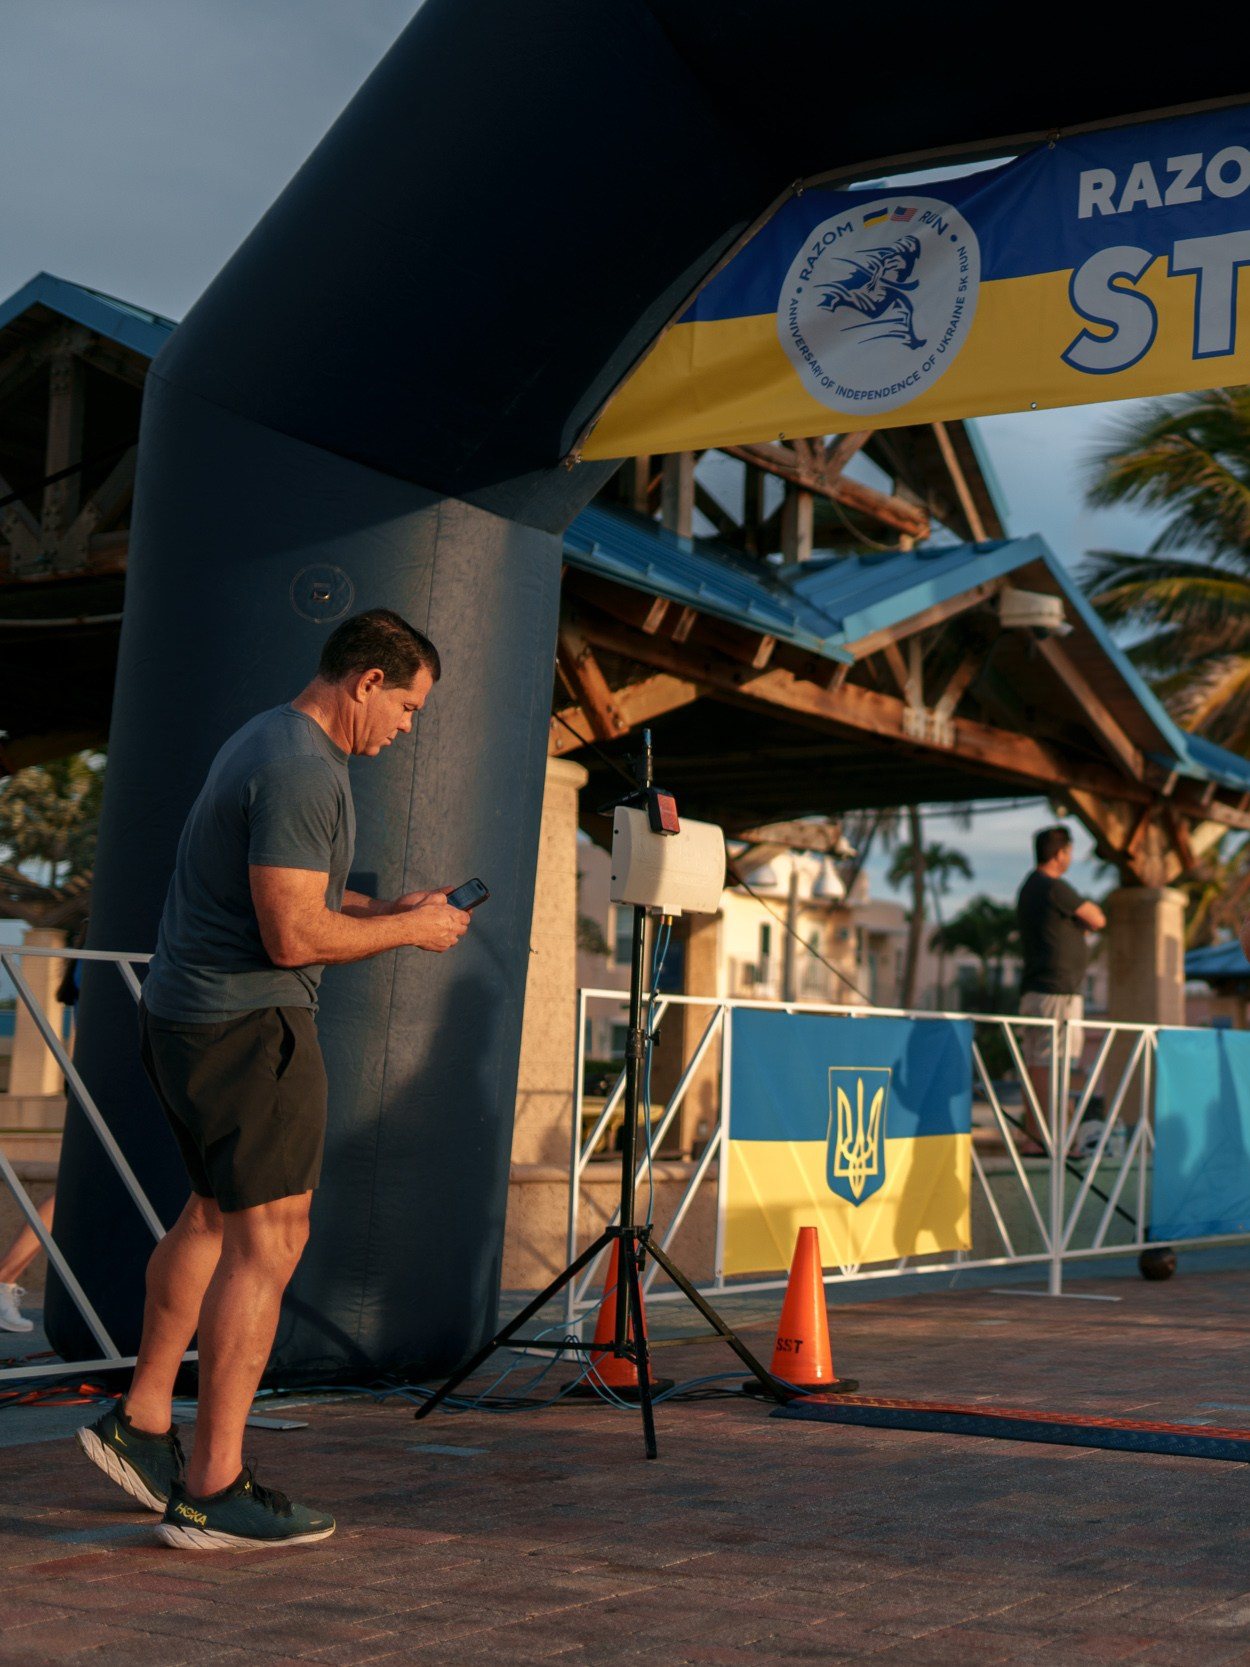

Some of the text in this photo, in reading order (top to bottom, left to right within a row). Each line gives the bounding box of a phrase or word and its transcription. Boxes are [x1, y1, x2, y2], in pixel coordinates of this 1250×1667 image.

[799, 210, 948, 282] RAZOM RUN
[788, 246, 969, 400] ANNIVERSARY OF INDEPENDENCE OF UKRAINE 5K RUN
[175, 1503, 207, 1526] HOKA
